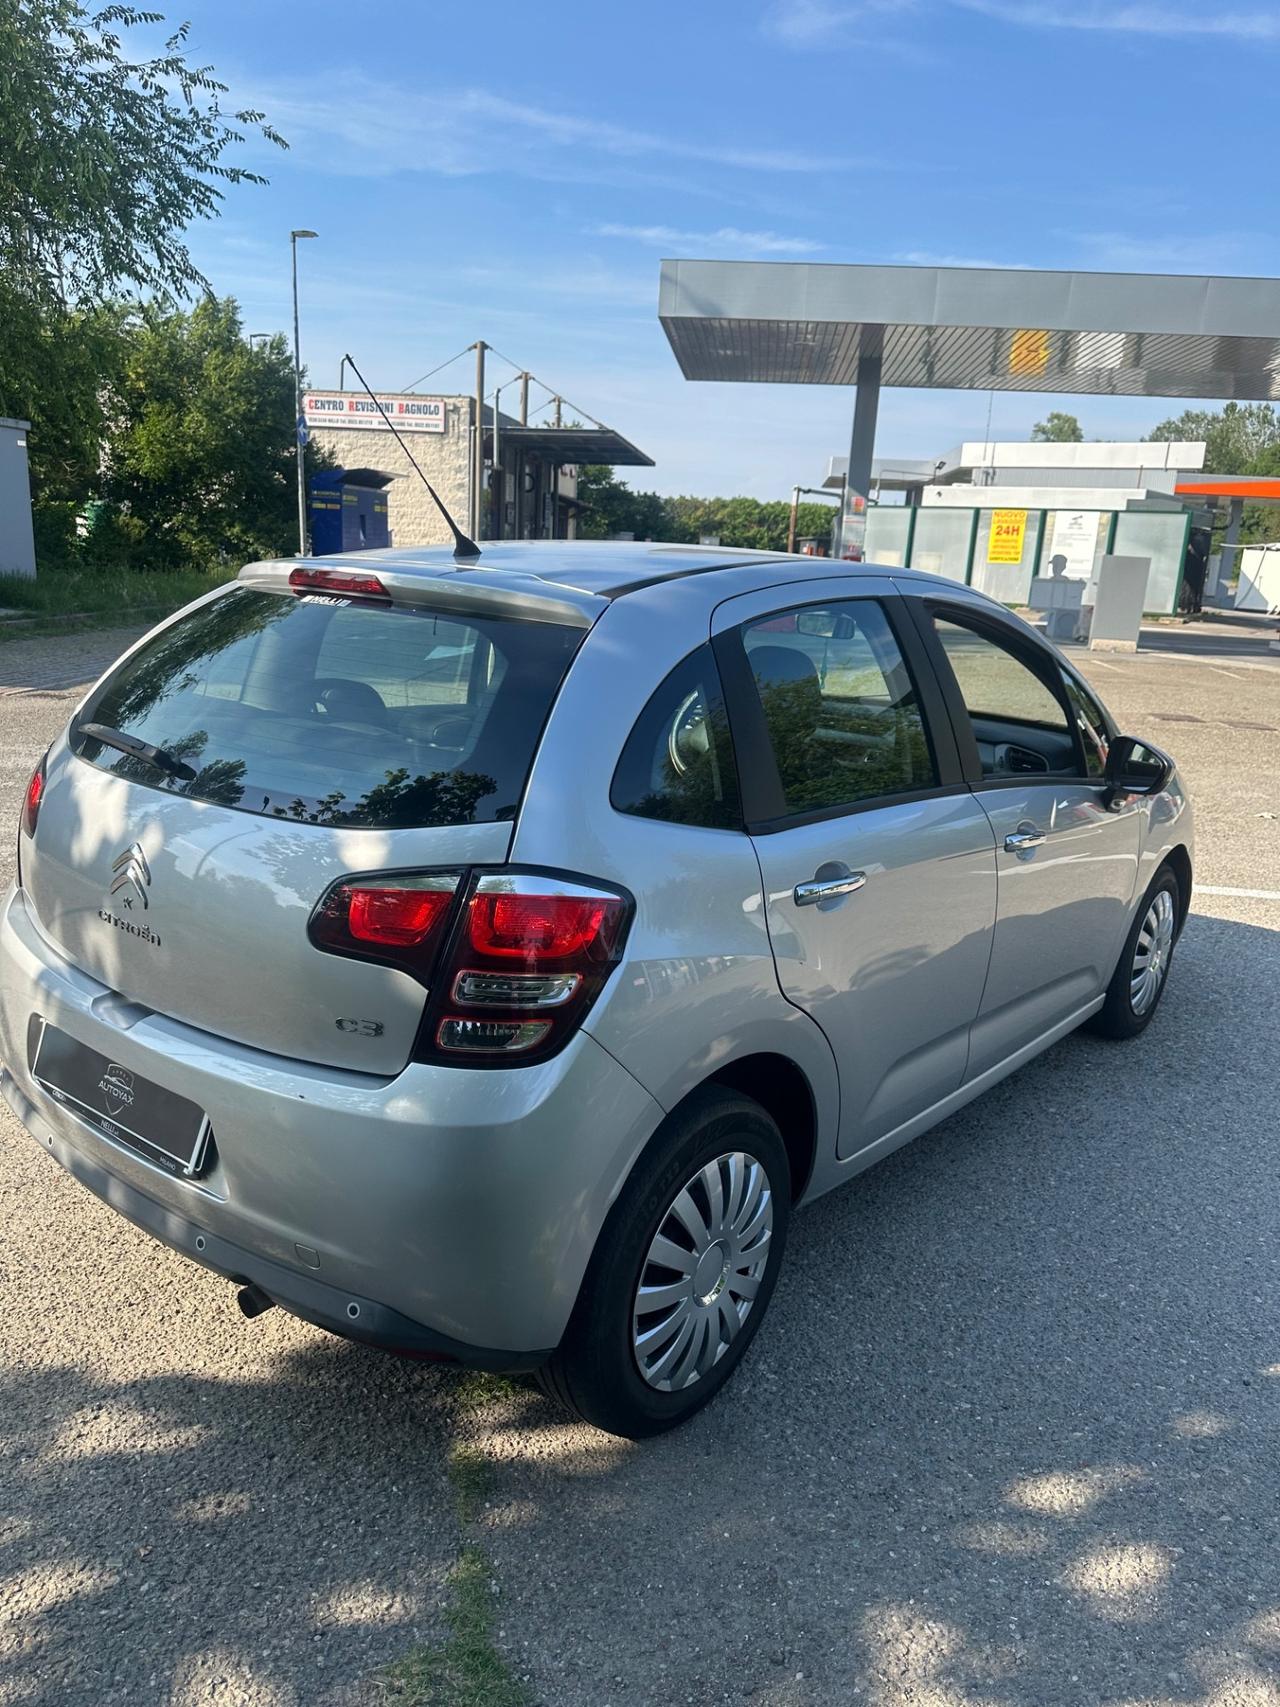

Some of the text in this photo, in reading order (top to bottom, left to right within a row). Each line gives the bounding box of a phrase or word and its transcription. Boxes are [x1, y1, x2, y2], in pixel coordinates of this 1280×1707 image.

[308, 399, 440, 415] CENTRO REVISIONI BAGNOLO
[995, 525, 1020, 536] 24H
[335, 1017, 384, 1037] C3
